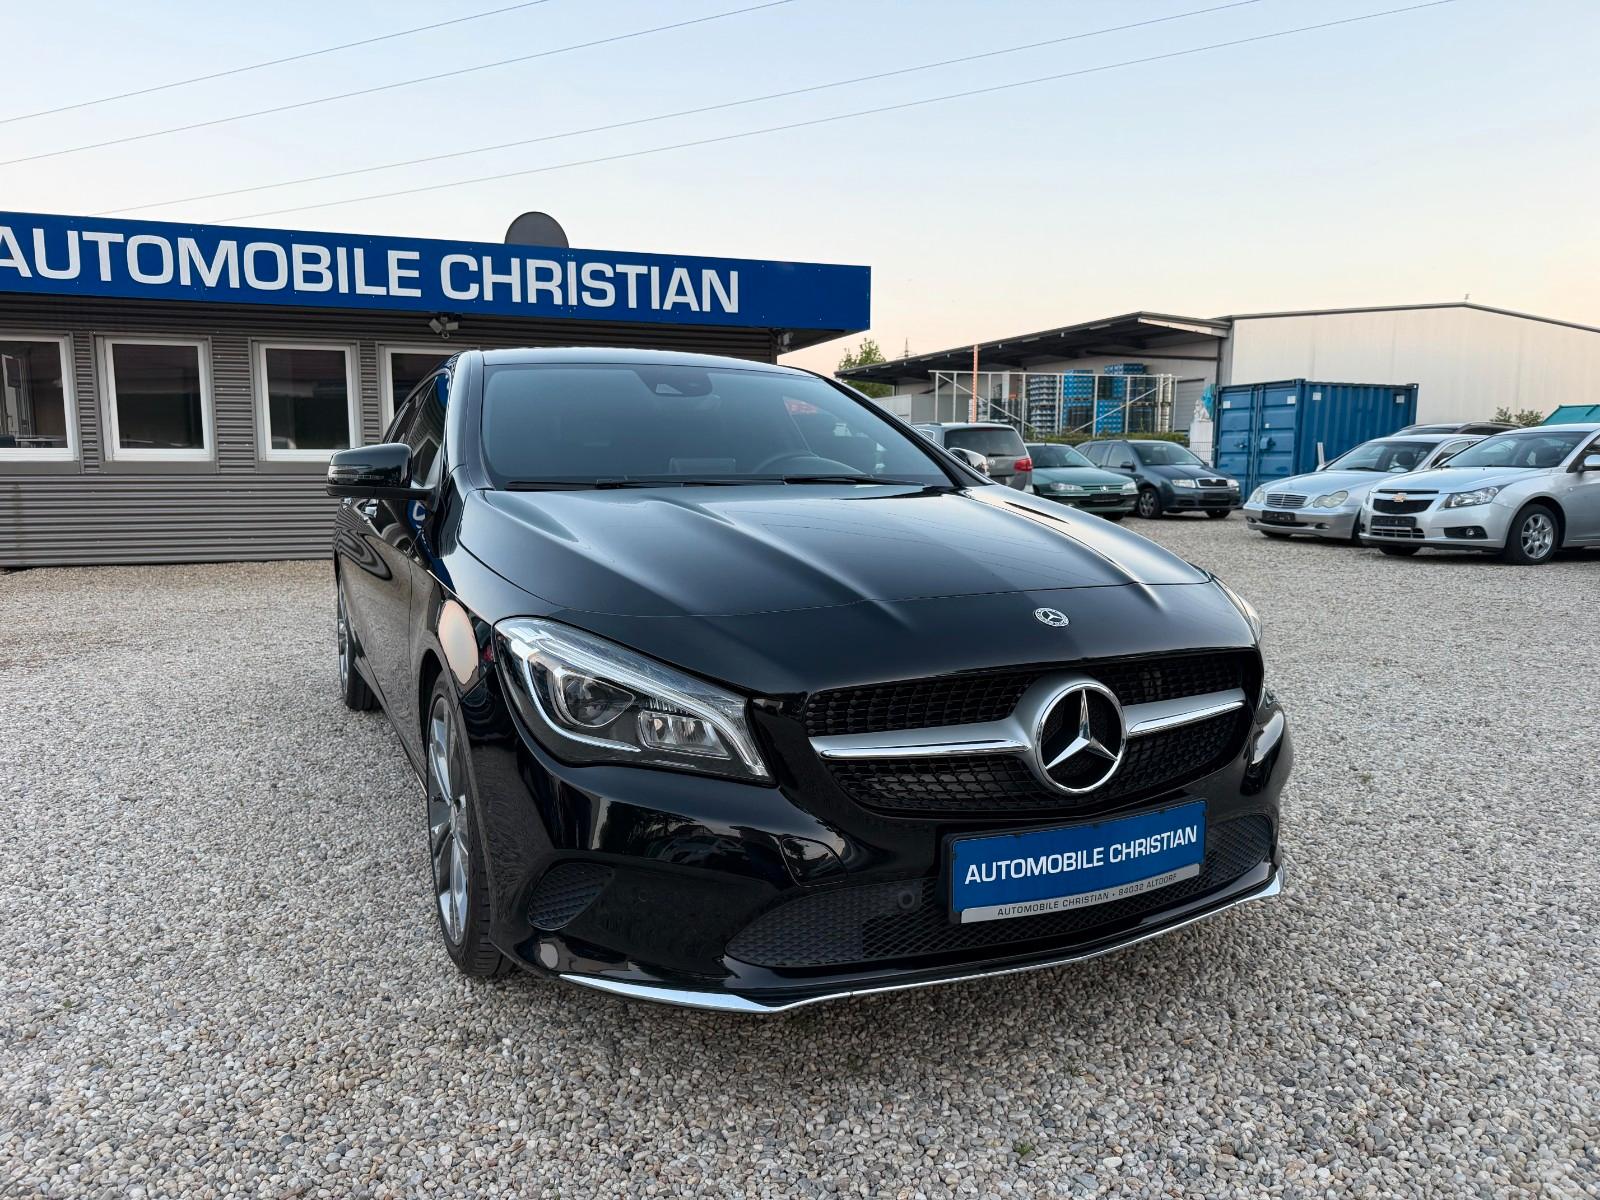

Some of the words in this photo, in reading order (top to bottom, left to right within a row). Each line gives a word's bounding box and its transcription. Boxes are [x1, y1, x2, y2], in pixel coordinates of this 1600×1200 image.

[0, 226, 422, 297] AUTOMOBILE
[440, 254, 739, 313] CHRISTIAN
[965, 848, 1104, 885] AUTOMOBILE
[1109, 825, 1197, 864] CHRISTIAN
[997, 902, 1059, 917] AUTOMOBILE
[1062, 892, 1109, 909] CHRISTIAN
[1118, 883, 1144, 897] 84032
[1146, 873, 1177, 889] ALTDORF
